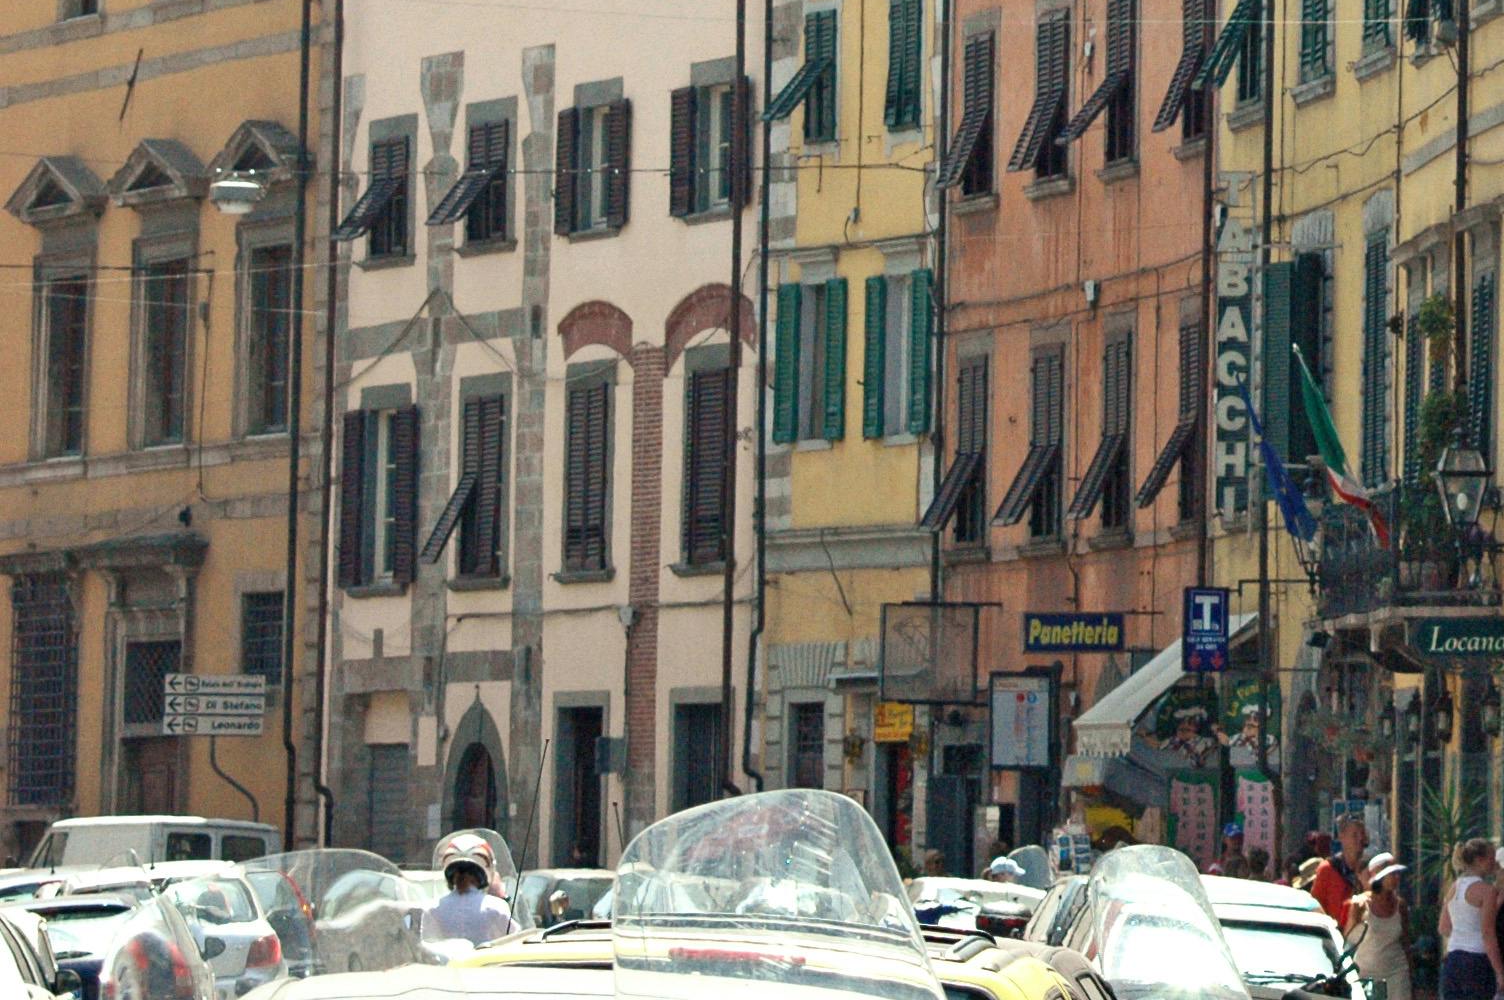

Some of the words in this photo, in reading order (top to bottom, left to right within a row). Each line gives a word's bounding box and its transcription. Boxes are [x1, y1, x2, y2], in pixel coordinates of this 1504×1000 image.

[1216, 170, 1252, 521] TABACCHI
[1195, 595, 1220, 630] T
[1029, 617, 1120, 646] Panetteria
[223, 700, 263, 710] Stefano
[212, 721, 260, 730] Leonardo
